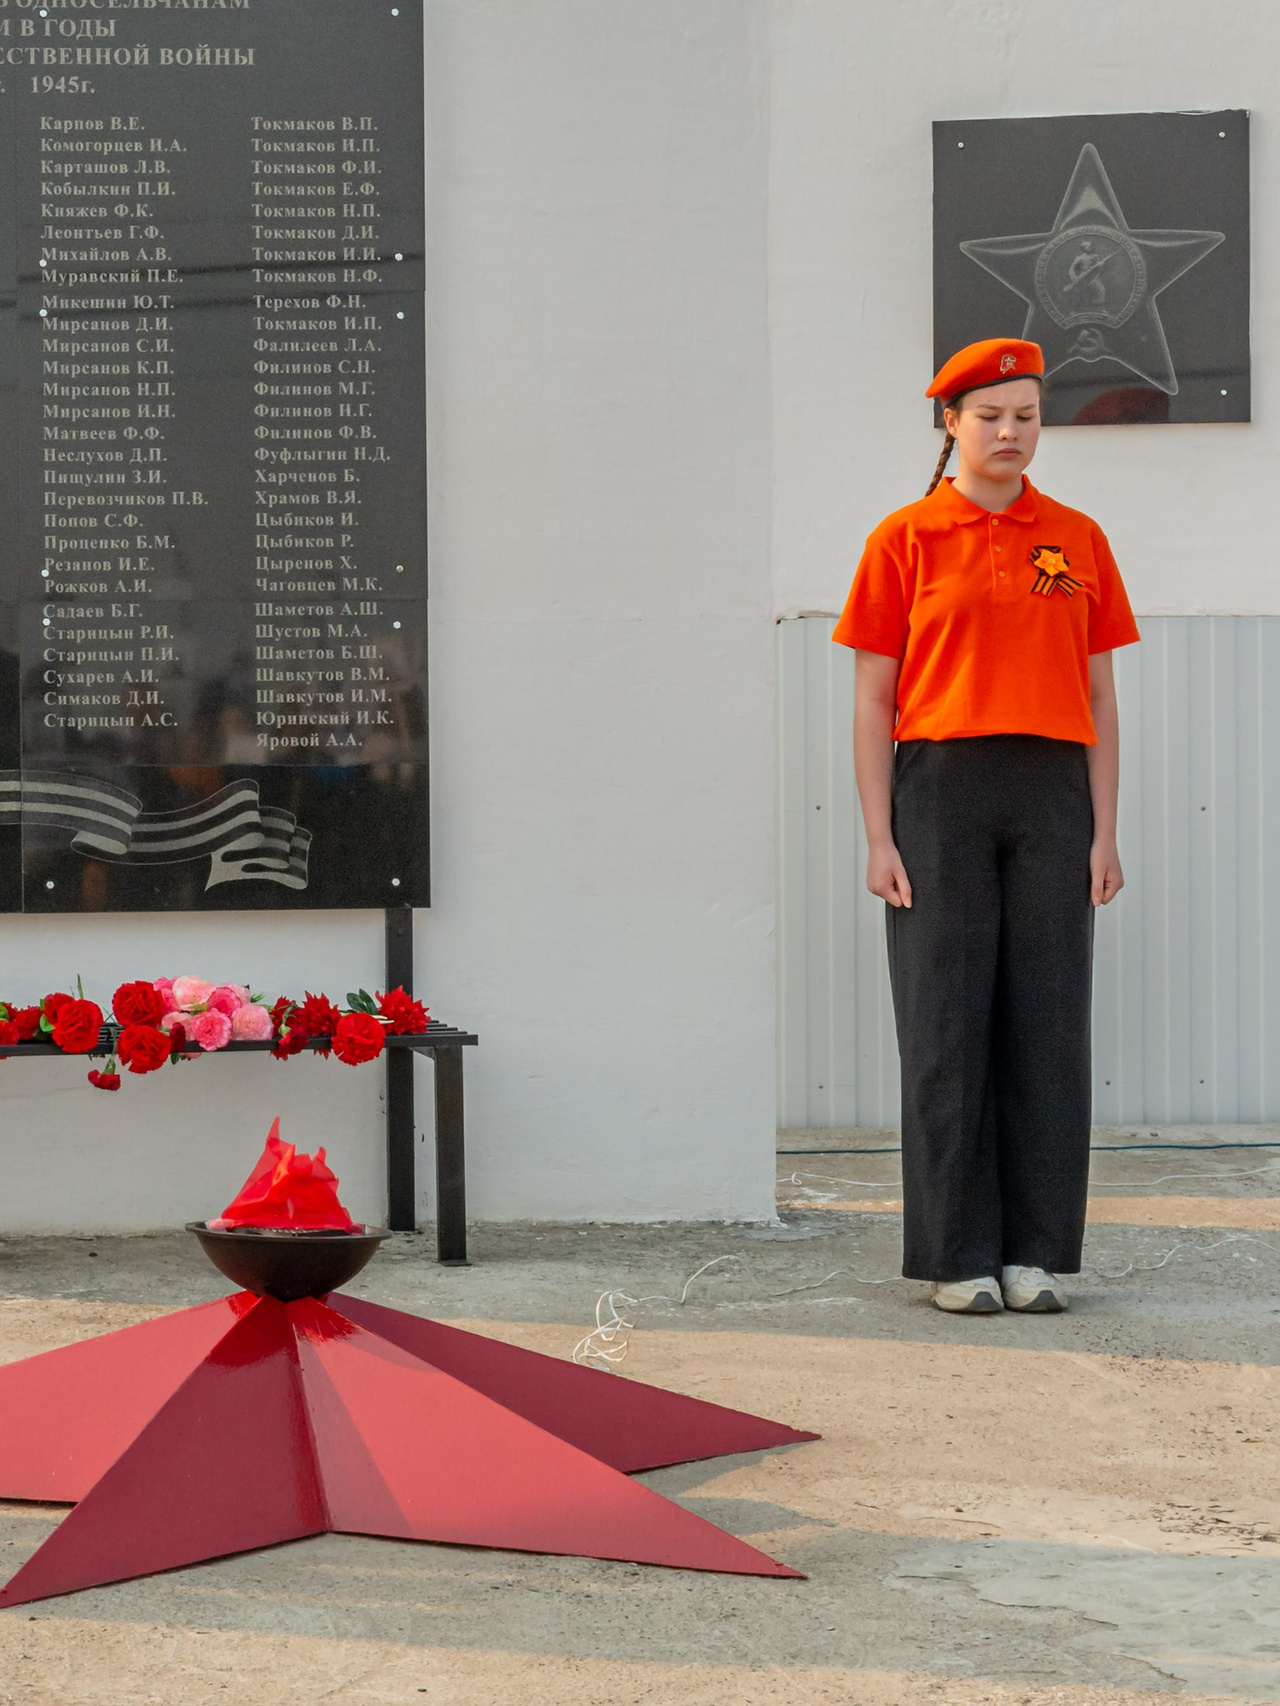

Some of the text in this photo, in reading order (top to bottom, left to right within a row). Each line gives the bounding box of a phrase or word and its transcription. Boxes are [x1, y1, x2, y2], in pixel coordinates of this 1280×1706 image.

[19, 18, 35, 38] В
[43, 18, 117, 41] ГОДЫ
[159, 43, 256, 66] ВОЙНЫ
[30, 75, 96, 94] 1945г.
[40, 115, 146, 134] Карпов В.Е.
[250, 116, 378, 131] Токмаков В.П.
[149, 137, 187, 152] И.А.
[250, 138, 380, 153] Токмаков И.П.
[40, 159, 171, 177] Карташов Л.В.
[251, 159, 382, 175] Токмаков Ф.И.
[40, 181, 176, 196] Кобылкин П.И.
[251, 181, 380, 196] Токмаков Е.Ф.
[40, 224, 165, 240] Леонтьев Г.Ф.
[251, 225, 379, 243] Токмаков Д.И.
[41, 294, 175, 310] Микешин Ю.Т.
[252, 294, 367, 312] Терехов Ф.Н.
[42, 338, 174, 356] Мирсанов С.И.
[43, 360, 175, 378] Мирсанов К.П.
[253, 381, 376, 396] Филинов М.Г.
[43, 425, 165, 441] Матвеев Ф.Ф.
[43, 447, 168, 465] Неслухов Д.П.
[354, 446, 391, 464] Н.Д.
[172, 491, 209, 506] П.В.
[254, 490, 362, 508] Храмов В.Я.
[44, 513, 144, 528] Попов С.Ф.
[255, 512, 359, 530] Цыбиков И.
[255, 533, 354, 552] Цыбиков Р.
[44, 578, 152, 593] Рожков А.И.
[342, 577, 383, 592] М.К.
[340, 602, 384, 617] А.Ш.
[255, 623, 368, 642] Шустов М.А.
[42, 646, 180, 665] Старицын П.И.
[121, 669, 159, 684] А.И.
[350, 667, 390, 682] В.М.
[43, 690, 165, 708] Симаков Д.И.
[350, 688, 393, 703] И.М.
[43, 713, 178, 731] Старицын А.С.
[256, 710, 395, 728] Юринский И.К.
[256, 732, 363, 750] Яровой А.А.
